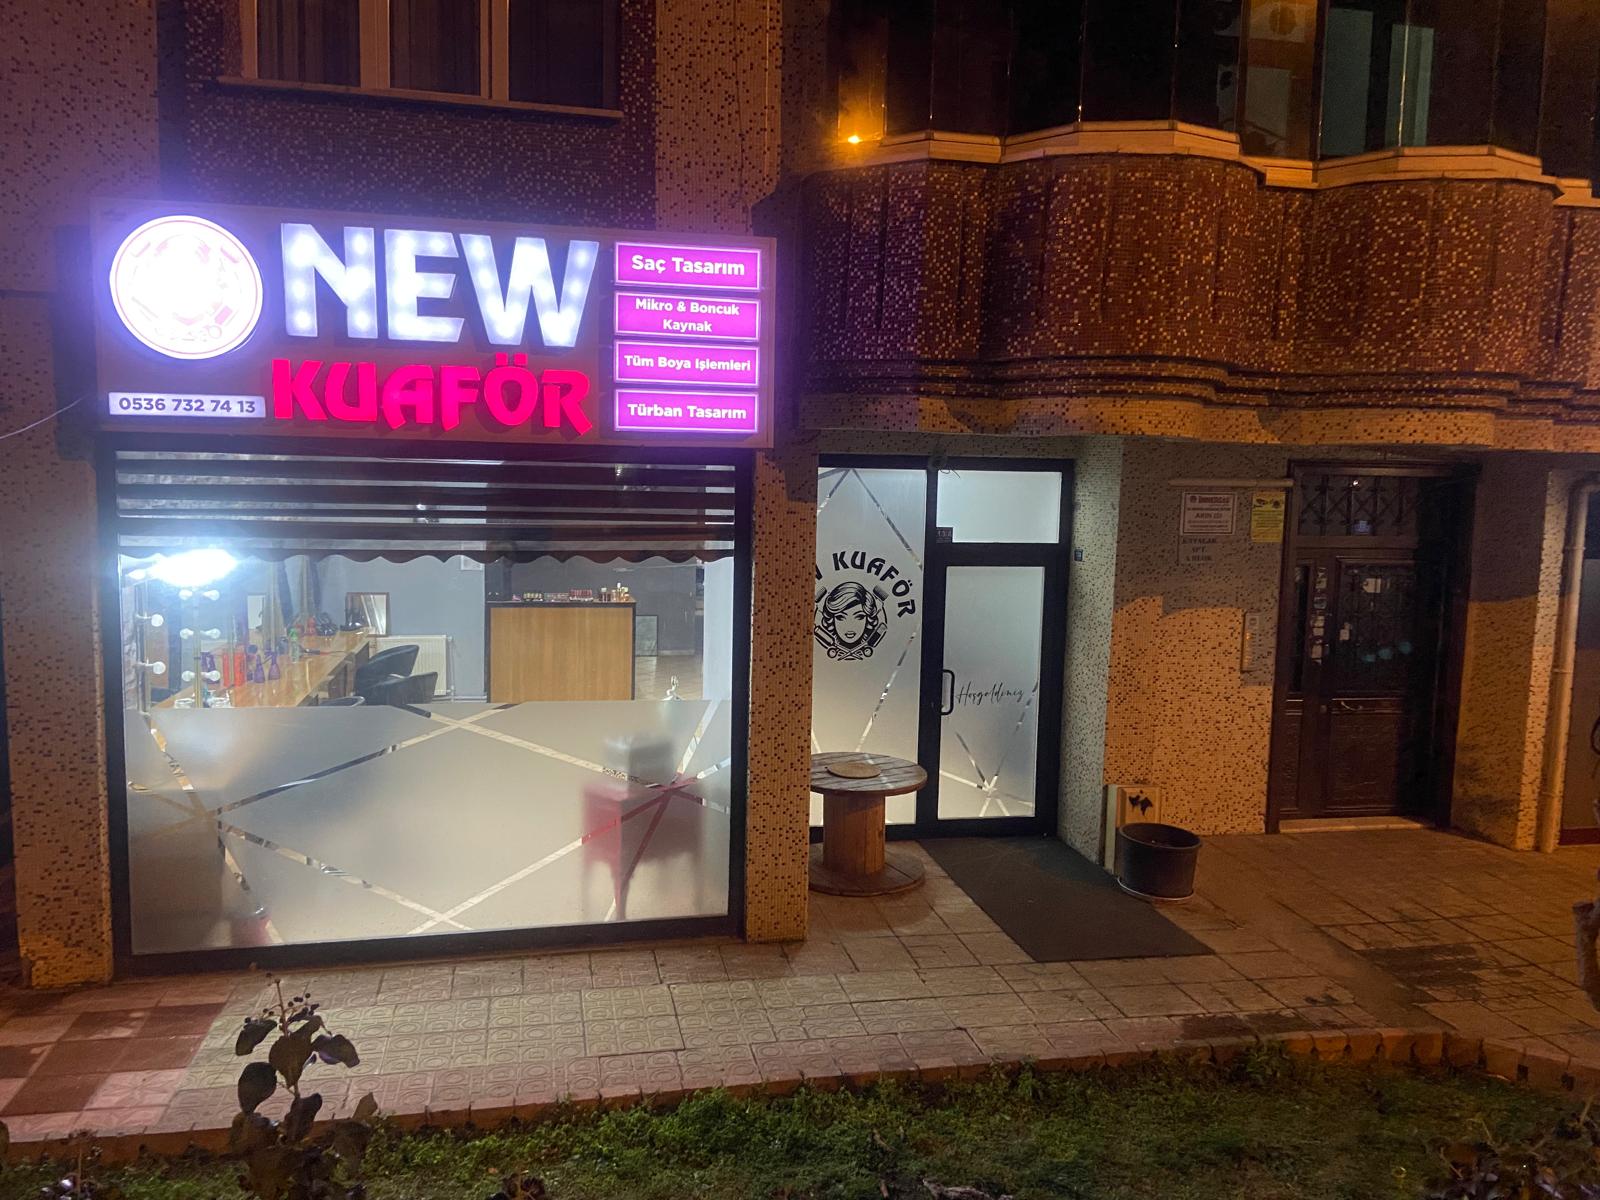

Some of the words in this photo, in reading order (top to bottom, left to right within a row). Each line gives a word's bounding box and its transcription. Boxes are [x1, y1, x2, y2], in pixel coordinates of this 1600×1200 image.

[631, 255, 666, 274] Saç
[672, 257, 745, 276] Tasarım
[281, 223, 599, 347] NEW
[635, 298, 673, 312] Mikro
[676, 301, 687, 313] &
[690, 302, 740, 316] Boncuk
[663, 319, 712, 333] Kaynak
[624, 355, 654, 368] Tüm
[658, 356, 691, 370] Boya
[272, 352, 593, 435] KUAFÖR
[119, 397, 166, 411] 0536
[172, 398, 205, 412] 732
[211, 400, 232, 413] 74
[237, 400, 256, 414] 13
[627, 403, 682, 417] Türban
[687, 405, 747, 420] Tasarım
[832, 551, 916, 618] KUAFÖR
